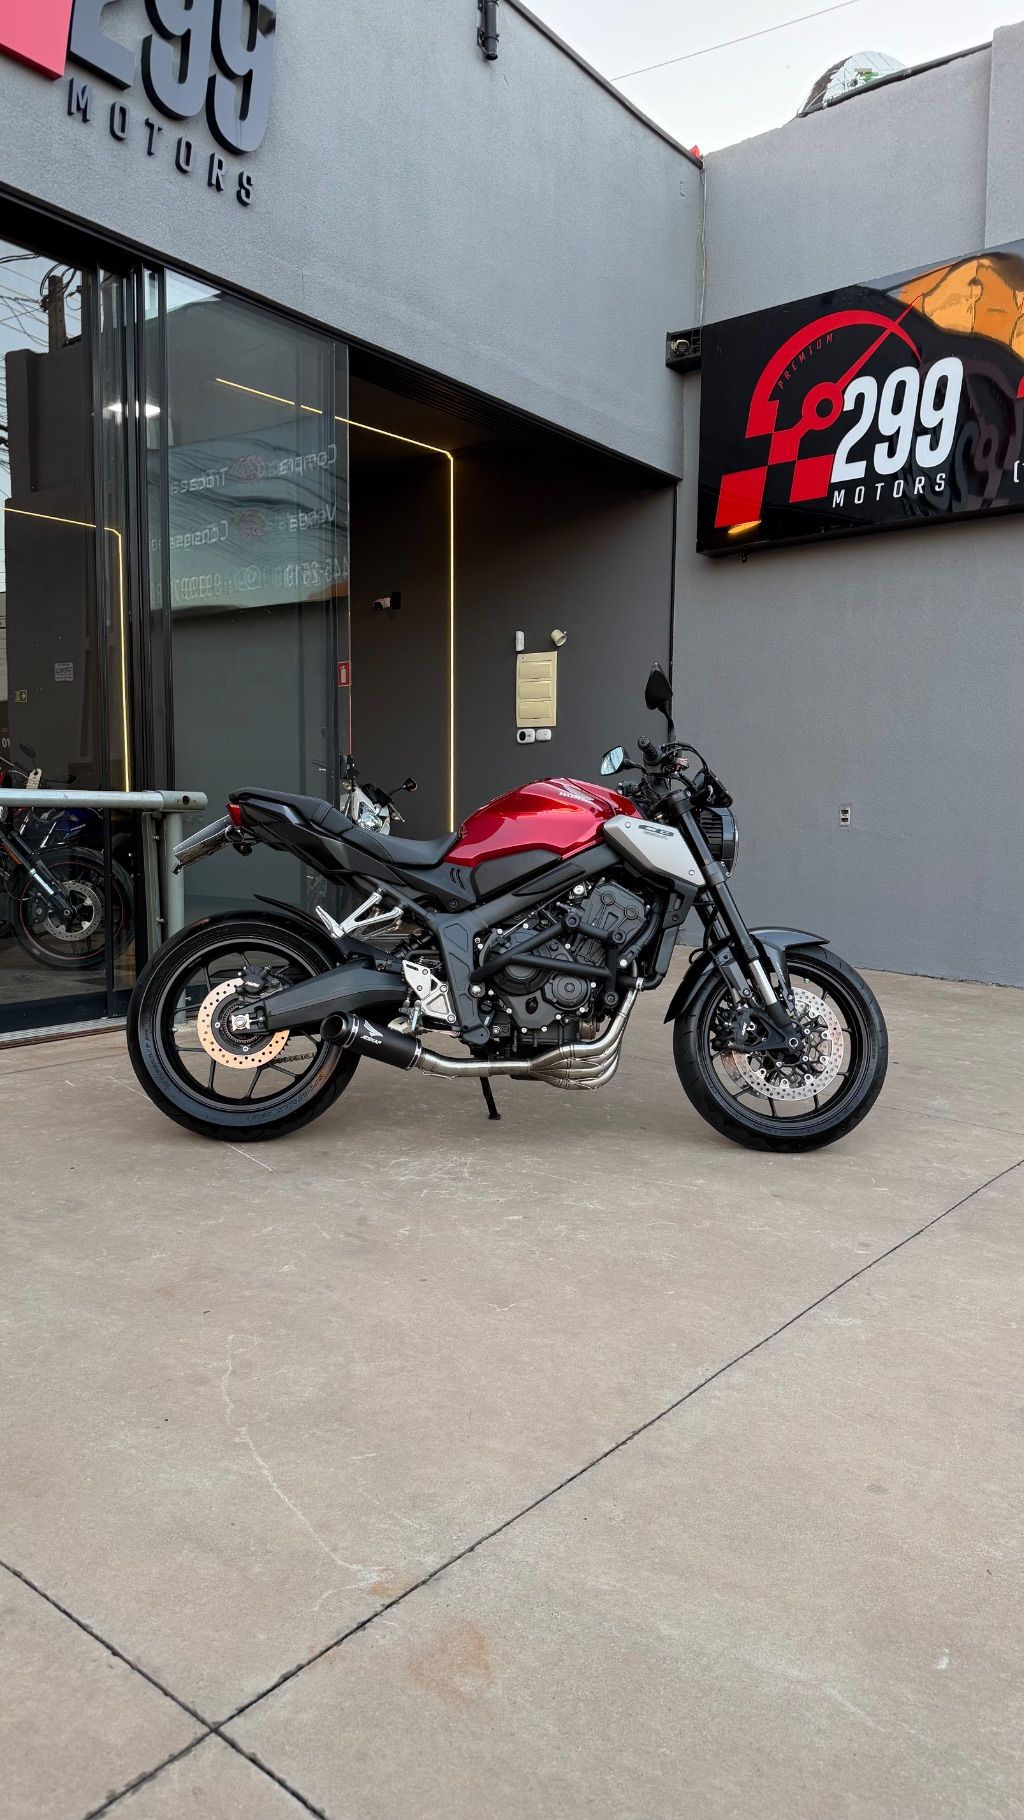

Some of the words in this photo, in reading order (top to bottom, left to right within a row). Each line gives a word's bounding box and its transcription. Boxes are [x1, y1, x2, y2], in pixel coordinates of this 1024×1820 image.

[67, 78, 255, 207] MOTORS
[778, 333, 833, 390] PREMIUM
[831, 356, 964, 484] 299
[832, 473, 946, 508] MOTORS
